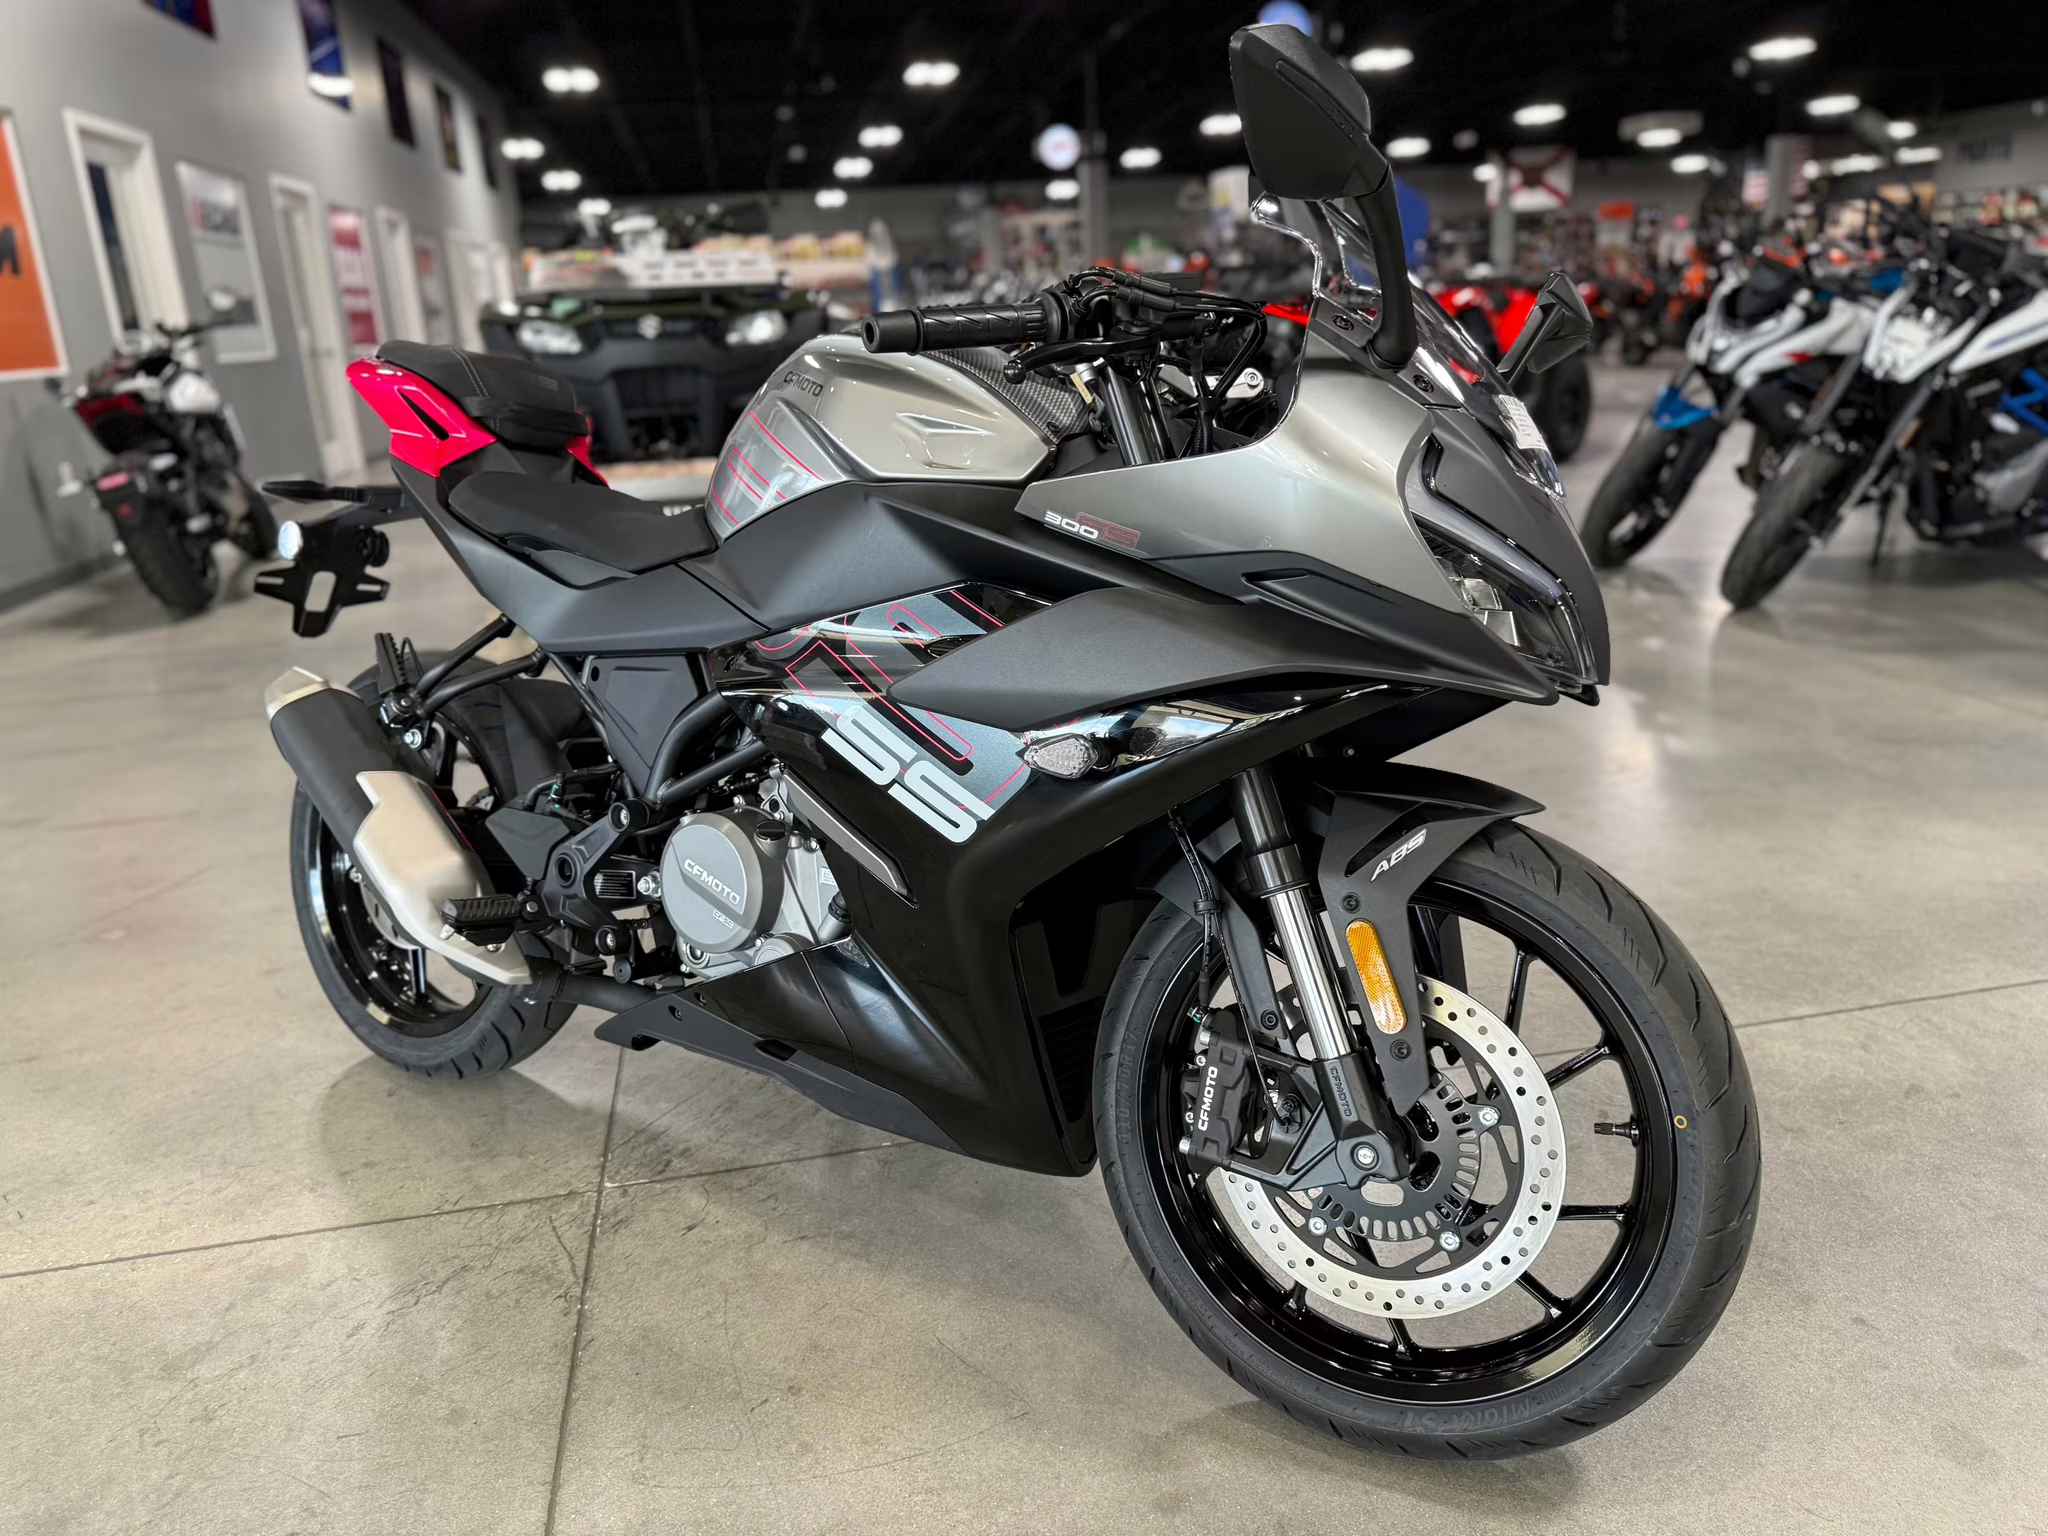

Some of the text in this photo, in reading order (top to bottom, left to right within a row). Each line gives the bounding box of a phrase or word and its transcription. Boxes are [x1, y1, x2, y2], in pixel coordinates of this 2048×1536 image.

[783, 370, 824, 397] CFMOTO
[821, 704, 996, 843] SS
[684, 858, 741, 905] CFMOTO
[1370, 828, 1427, 882] ABS
[1197, 1065, 1218, 1132] CFMOTO
[1330, 1065, 1352, 1117] CFMOTO
